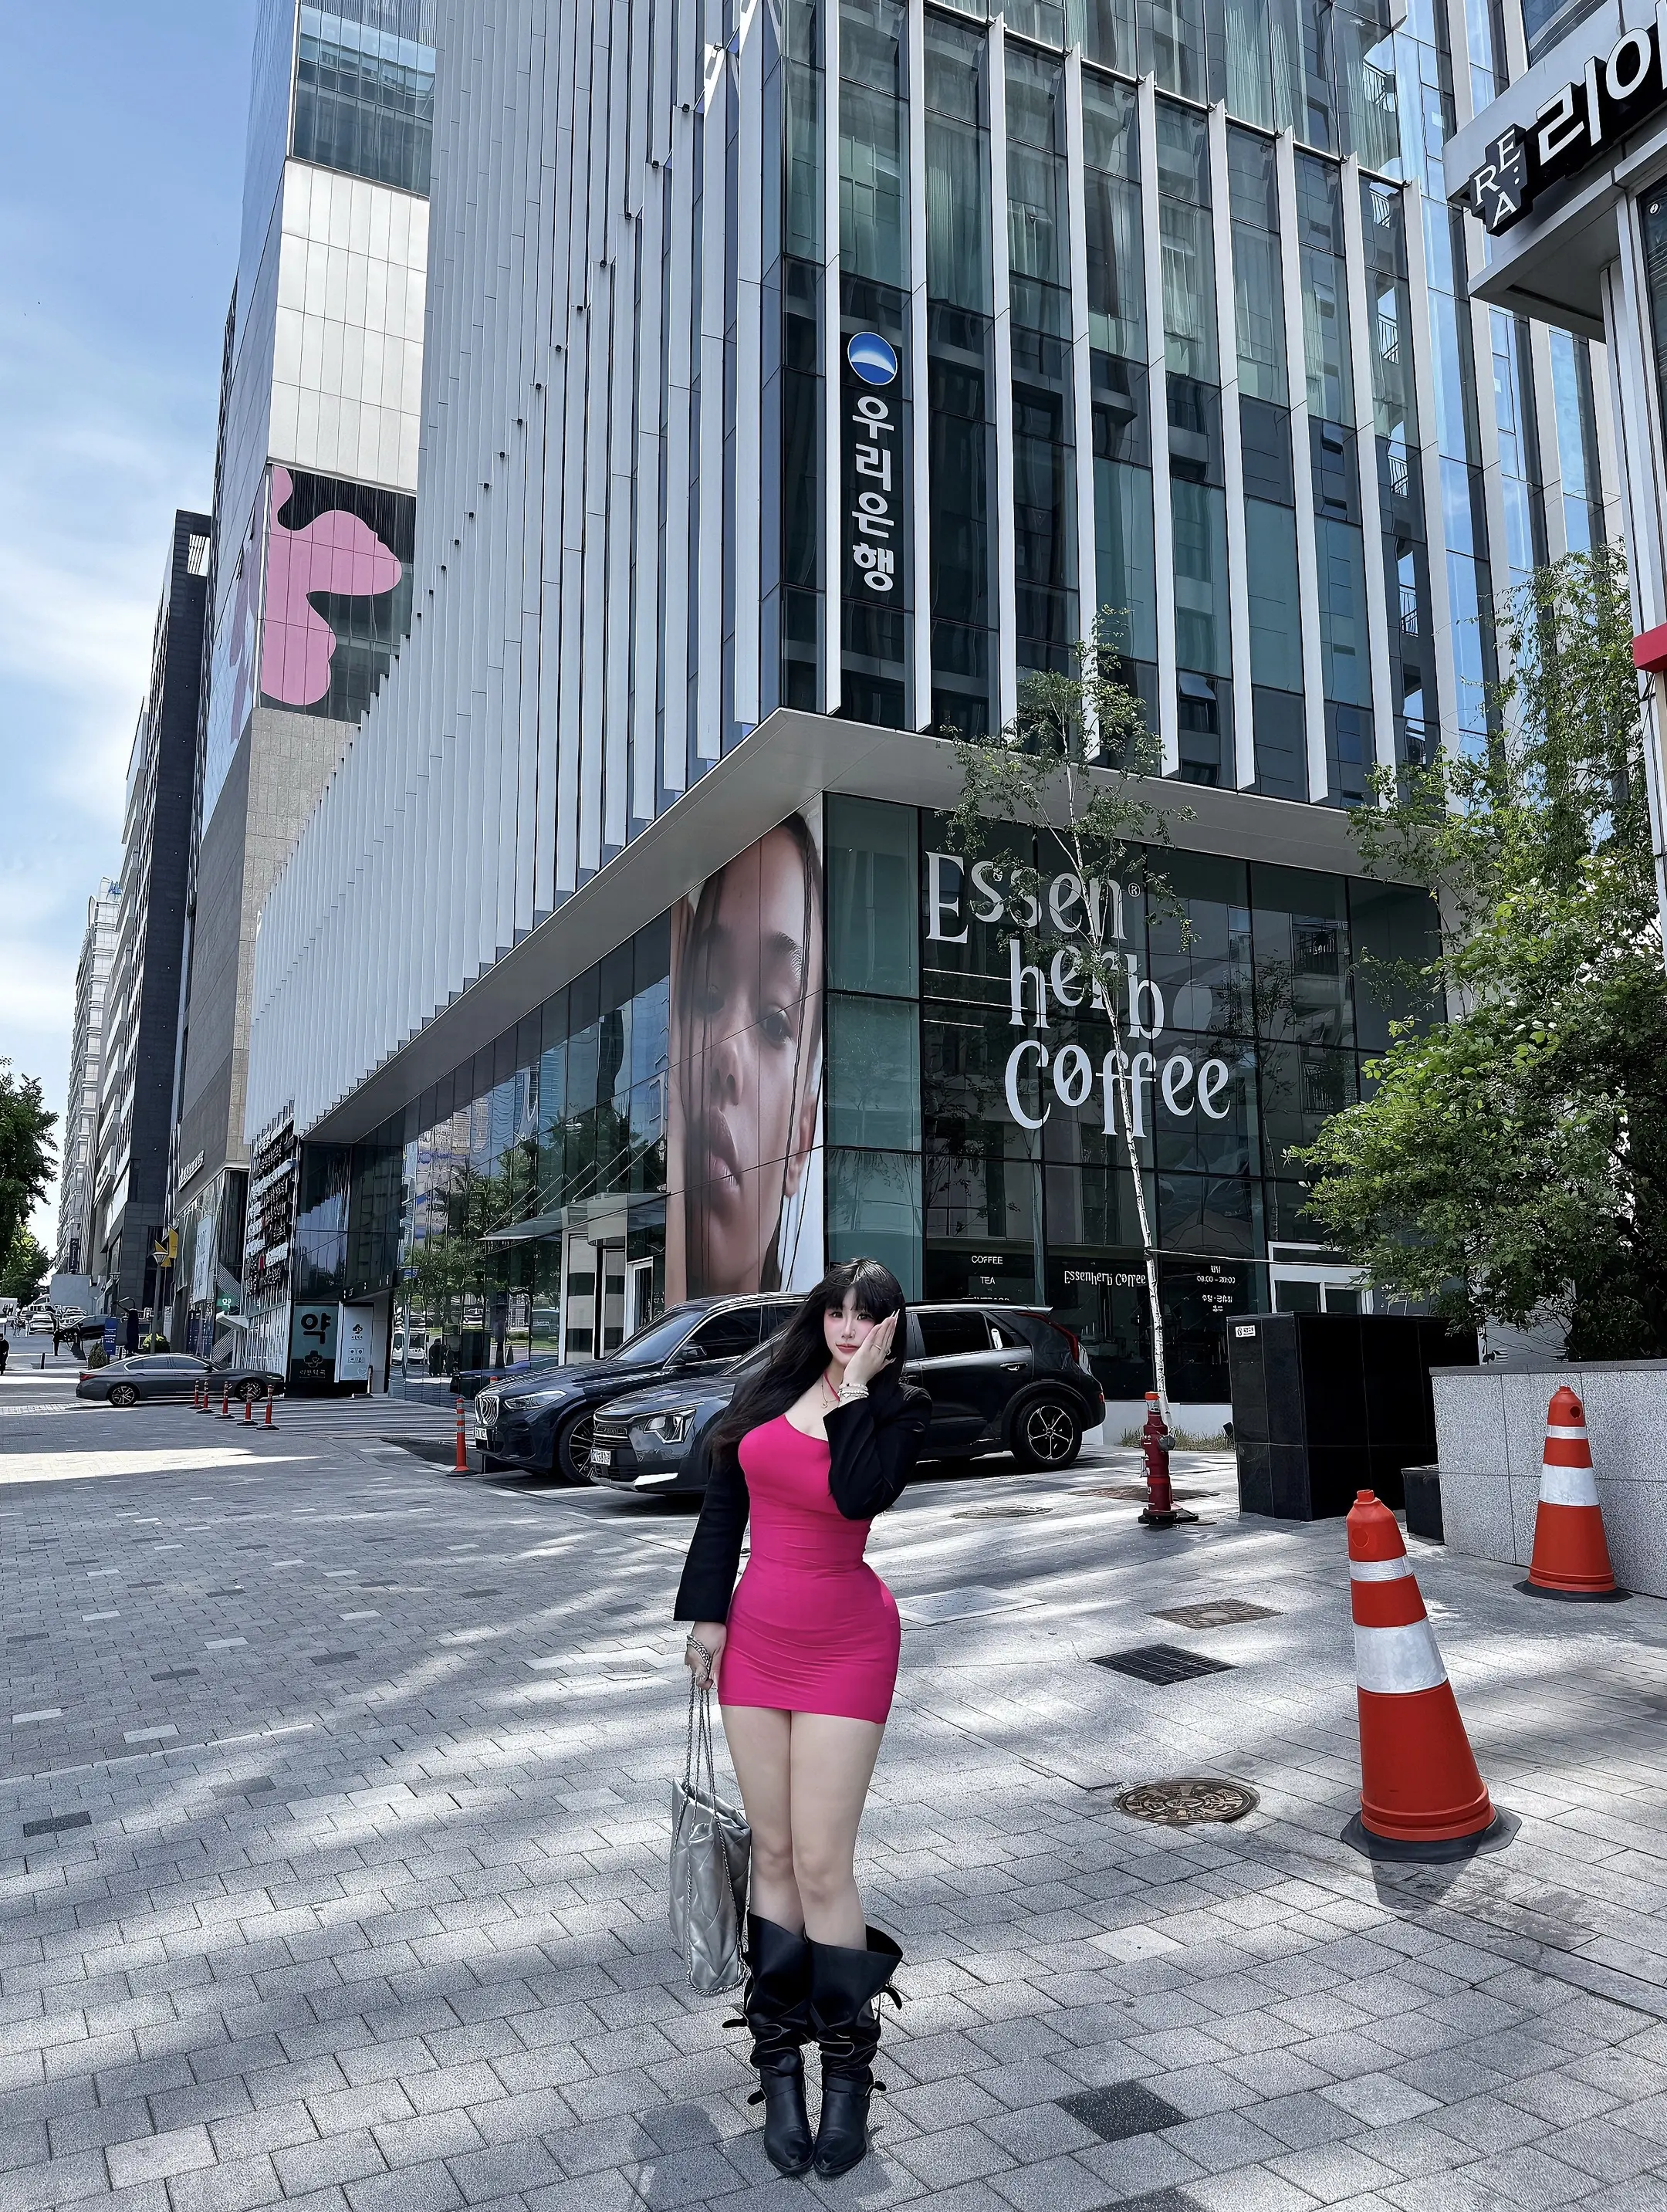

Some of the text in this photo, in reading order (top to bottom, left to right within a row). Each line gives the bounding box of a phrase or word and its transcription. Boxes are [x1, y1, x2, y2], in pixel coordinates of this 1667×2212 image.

[851, 395, 894, 592] 우리은행
[1008, 939, 1165, 1040] herb
[1004, 1040, 1231, 1138] Coffee
[971, 1255, 1003, 1265] COFFEE
[979, 1276, 996, 1285] TEA
[300, 1312, 332, 1345] 약
